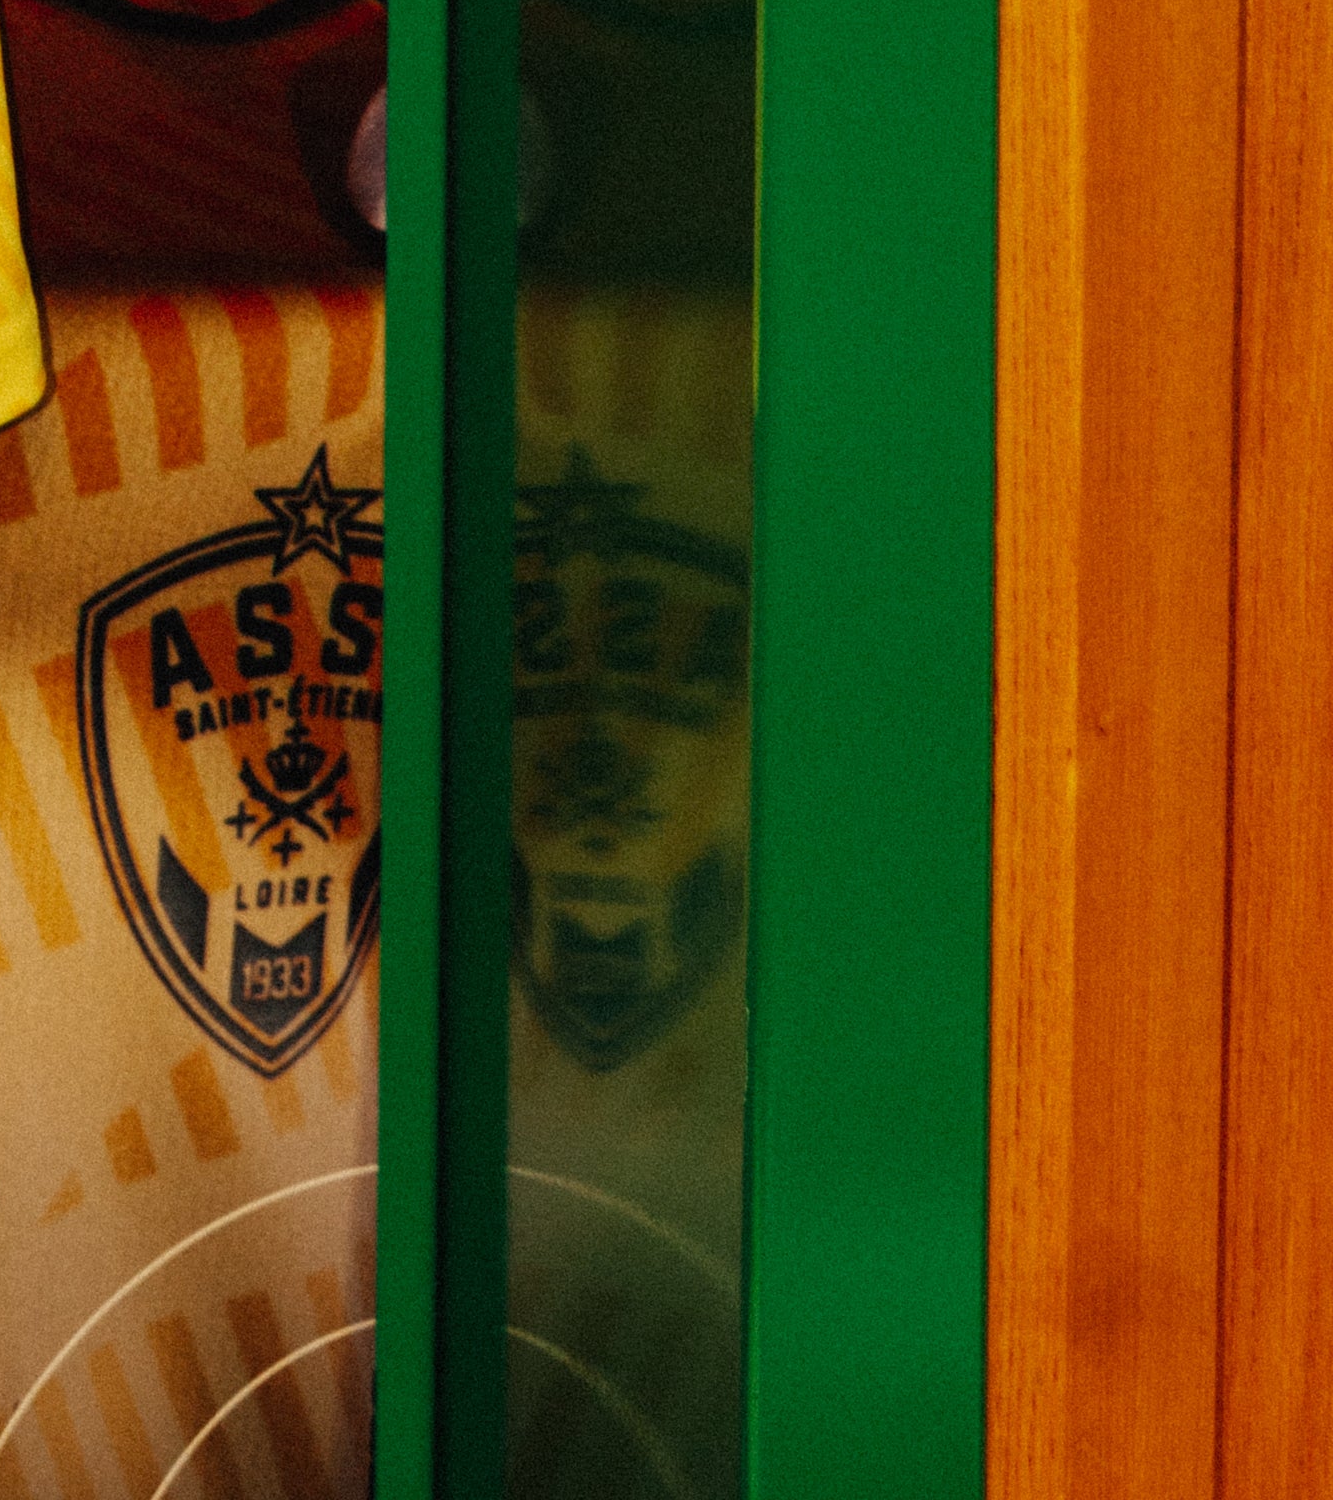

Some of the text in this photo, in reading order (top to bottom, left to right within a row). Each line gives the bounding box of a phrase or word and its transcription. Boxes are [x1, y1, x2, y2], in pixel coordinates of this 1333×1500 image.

[150, 582, 383, 709] ASS
[235, 875, 332, 911] LOIRE
[241, 955, 313, 1000] 1933
